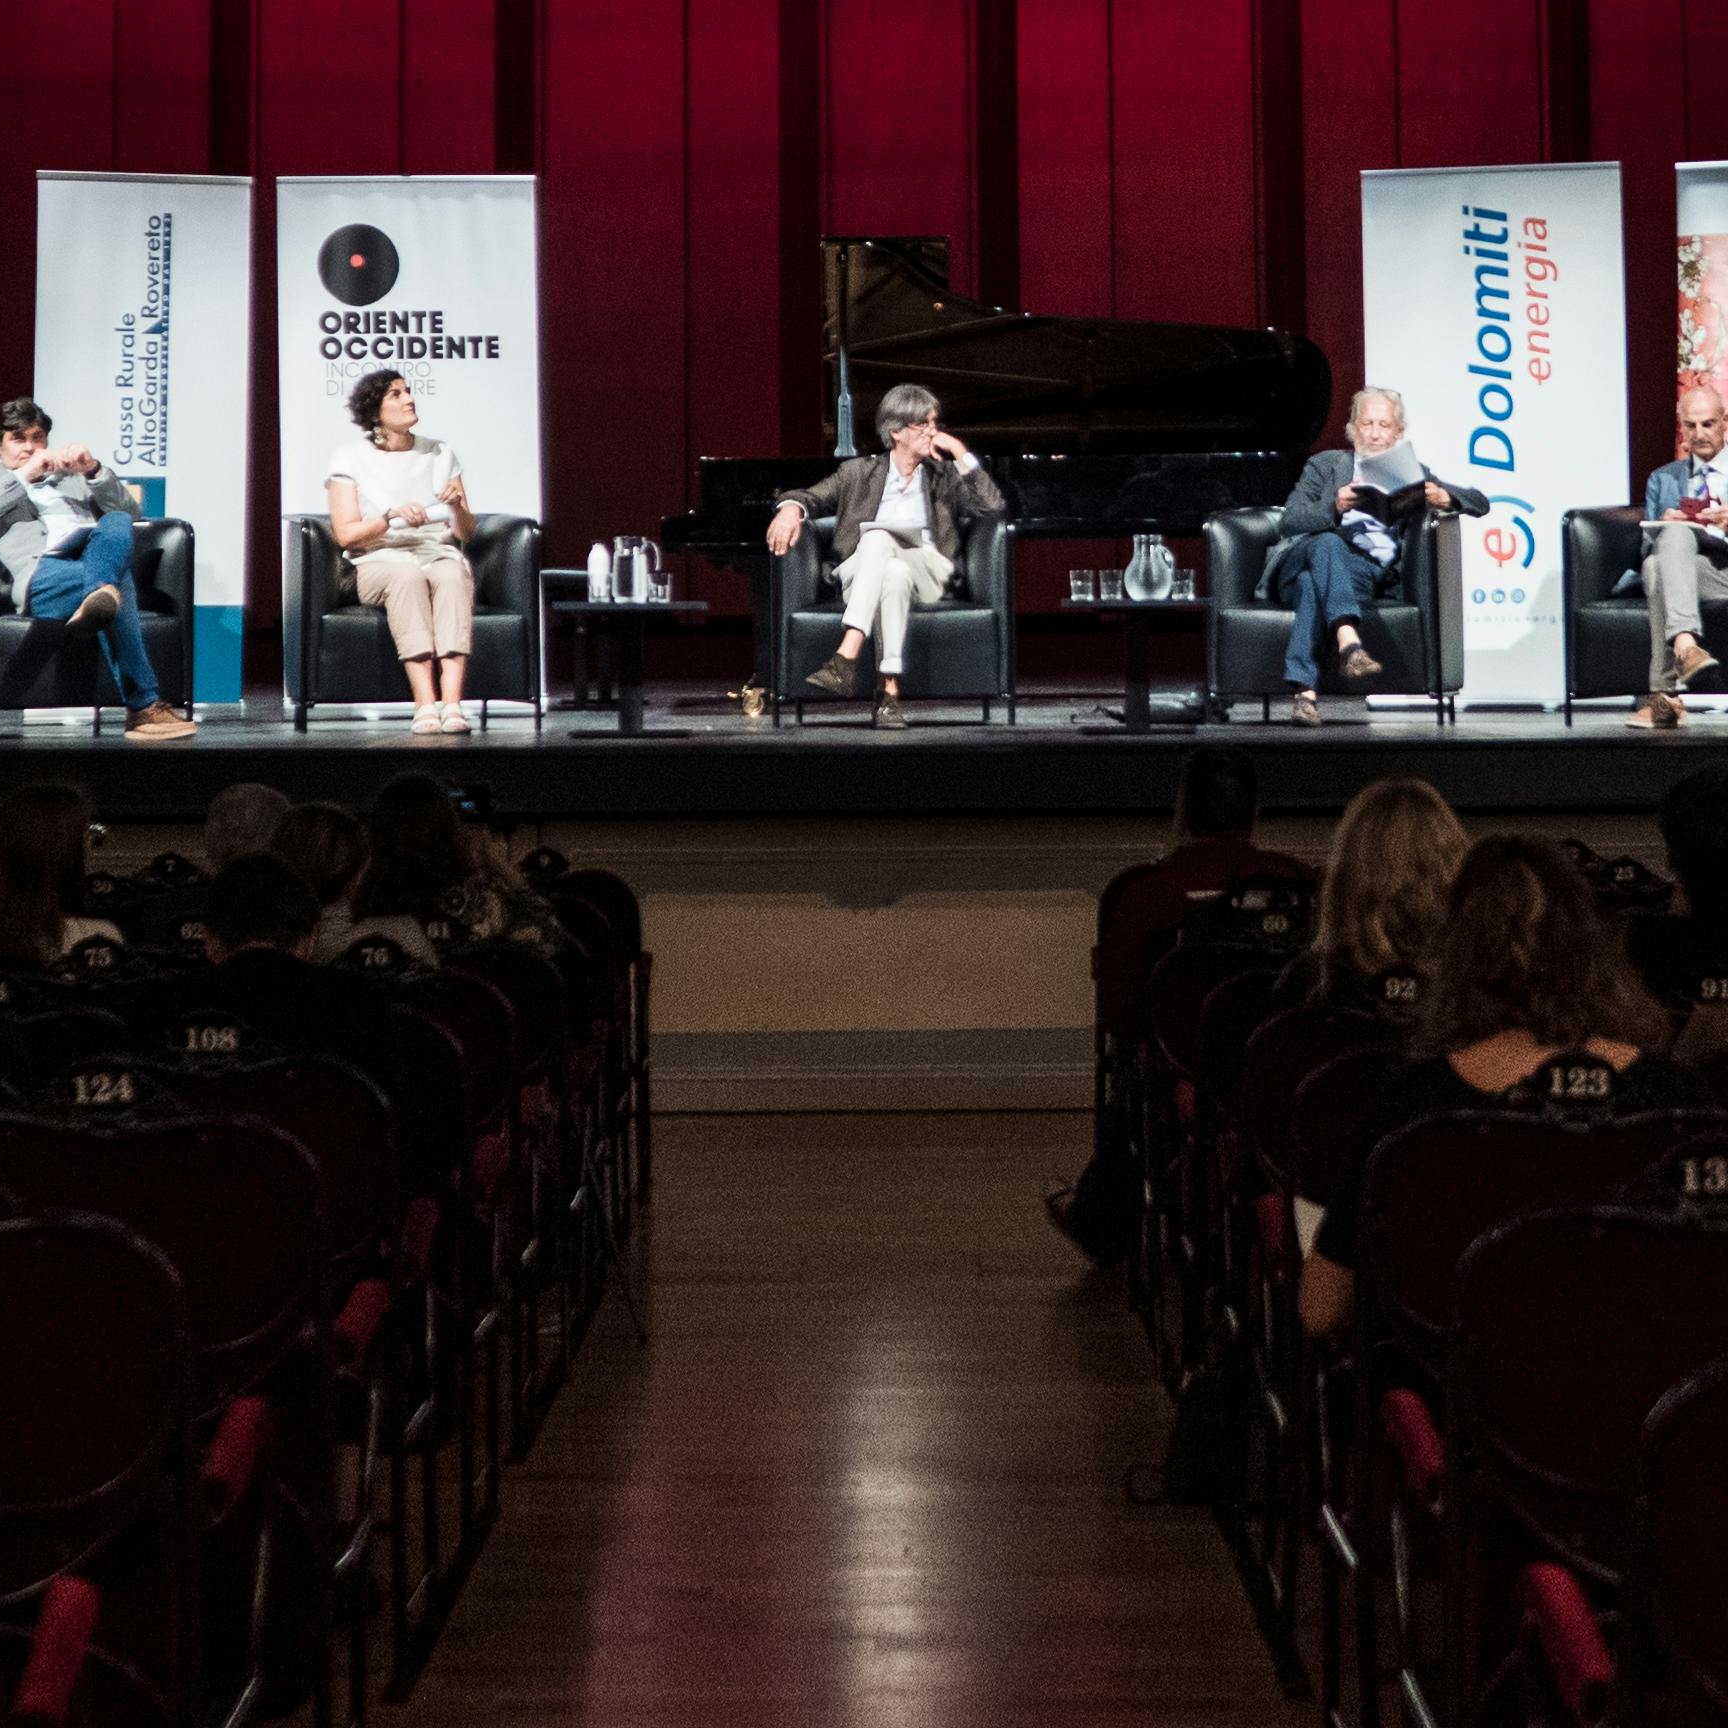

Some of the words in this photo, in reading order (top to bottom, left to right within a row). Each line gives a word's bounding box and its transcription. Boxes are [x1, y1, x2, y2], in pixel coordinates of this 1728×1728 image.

[140, 215, 161, 318] Rovereto
[319, 310, 444, 334] ORIENTE
[1517, 216, 1559, 386] energia
[114, 312, 135, 387] Rurale
[320, 336, 500, 360] OCCIDENTE
[1462, 205, 1515, 472] Dolomiti
[136, 341, 158, 466] AltoGarda
[113, 397, 133, 465] Cassa
[1385, 978, 1417, 1001] 92
[186, 1027, 238, 1051] 108
[75, 1073, 134, 1104] 124
[1550, 1067, 1609, 1097] 123
